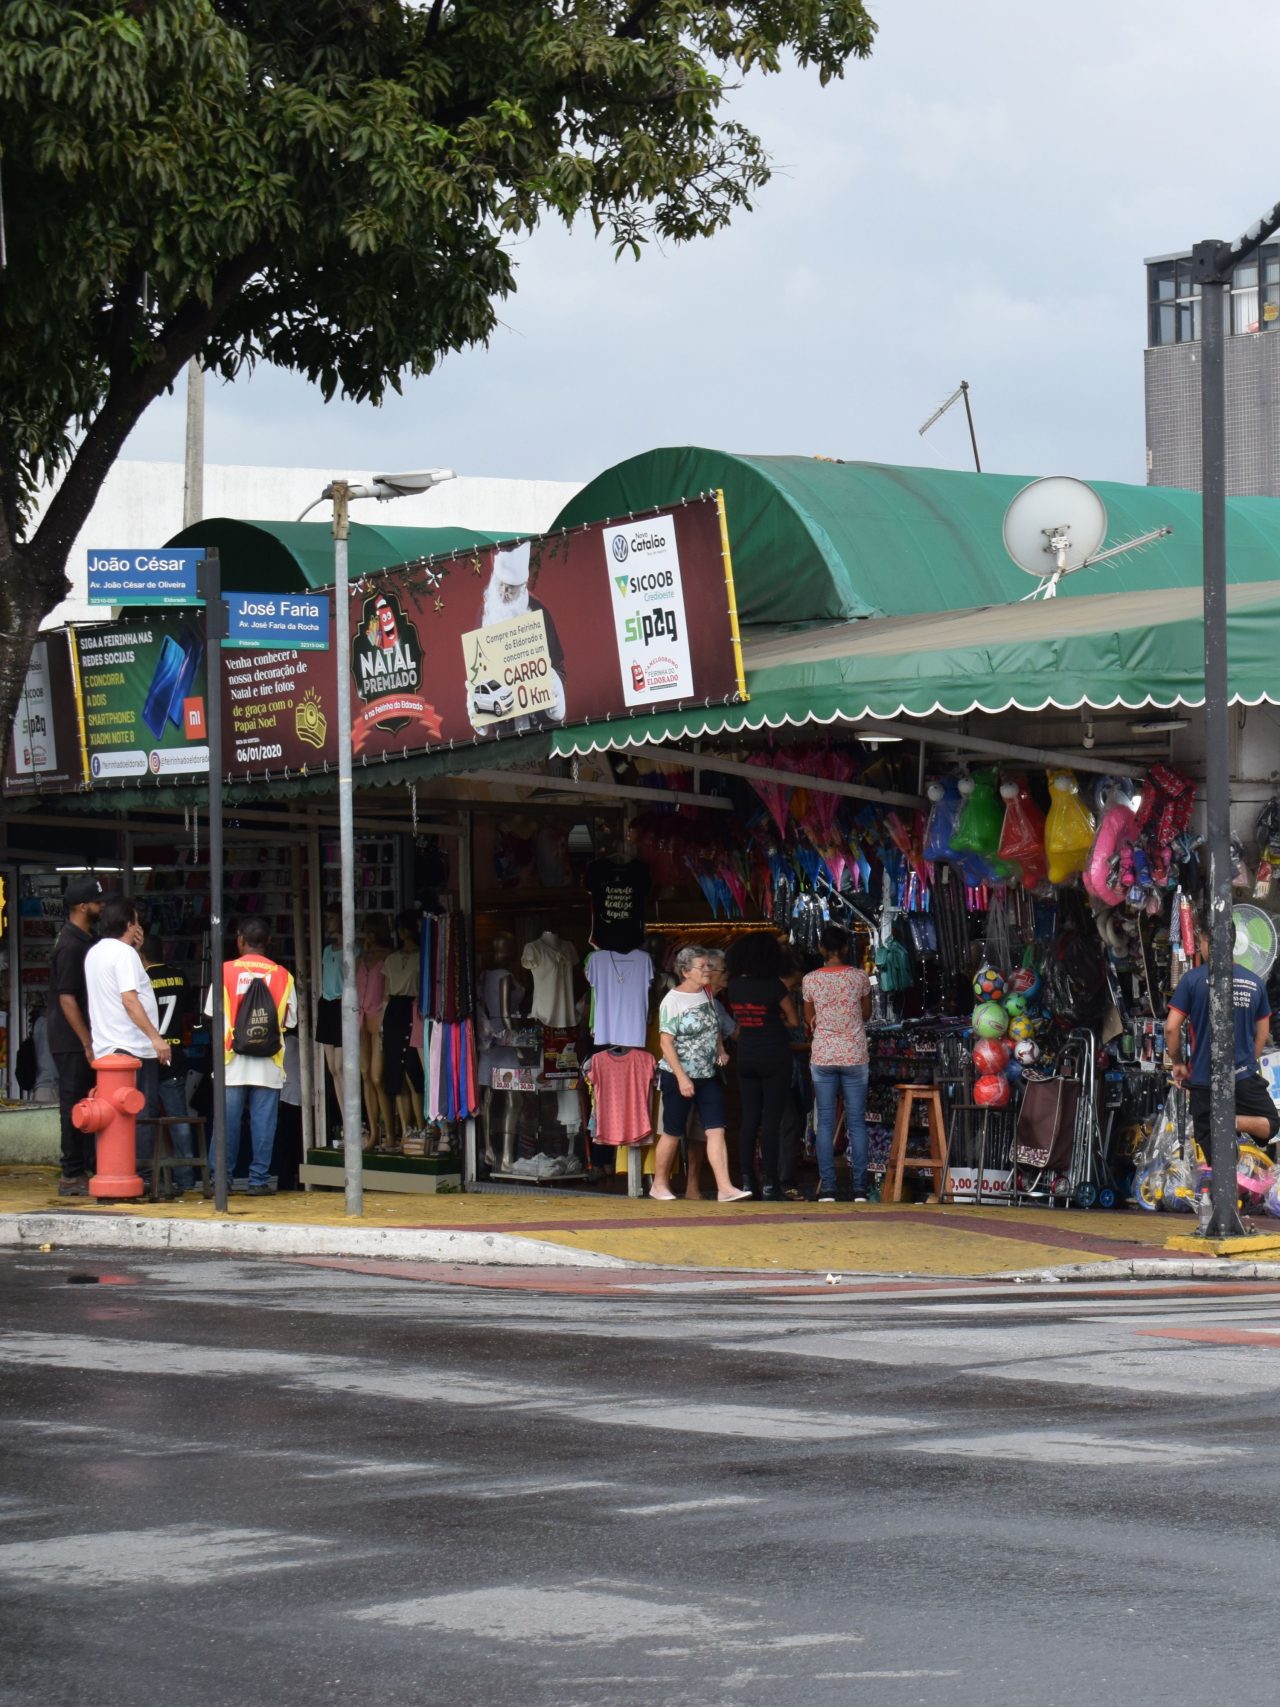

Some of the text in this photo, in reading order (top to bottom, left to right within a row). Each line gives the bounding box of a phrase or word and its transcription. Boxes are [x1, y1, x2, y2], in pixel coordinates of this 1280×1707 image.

[631, 534, 665, 552] Catalão
[88, 556, 186, 572] João César
[103, 581, 121, 589] João
[630, 570, 673, 593] SICOOB
[644, 591, 675, 601] Credioeste
[239, 600, 319, 617] José Faria
[269, 622, 286, 630] Faria
[287, 622, 296, 630] da
[298, 623, 319, 631] Rocha
[486, 621, 541, 644] Compre na Feirinha
[80, 631, 152, 650] SIGA A FEIRINHA NAS
[504, 641, 512, 650] do
[513, 635, 538, 648] Eldorado
[82, 651, 135, 667] REDES SOCIAIS
[225, 650, 298, 670] Venha conhecer a
[360, 642, 416, 678] NATAL
[503, 650, 529, 663] concorra
[535, 645, 544, 653] um
[84, 672, 125, 688] E CONCORRA
[228, 661, 308, 685] nossa decoração de
[504, 657, 547, 686] CARRO
[647, 674, 678, 685] ELDORADO
[231, 681, 295, 700] Natal e tire fotos
[363, 670, 417, 694] PREMIADO
[87, 694, 107, 706] A DOIS
[517, 685, 550, 708] 0 Km
[232, 699, 293, 718] de graça com o
[368, 710, 375, 718] na
[375, 703, 394, 714] Feirinha
[401, 700, 423, 711] Eldorado
[88, 711, 135, 726] SMARTPHONES
[234, 715, 277, 733] Papai Noel
[90, 732, 111, 745] XIAOMI
[112, 731, 128, 744] NOTE
[236, 744, 282, 762] 06/01/2020
[158, 995, 177, 1035] 7
